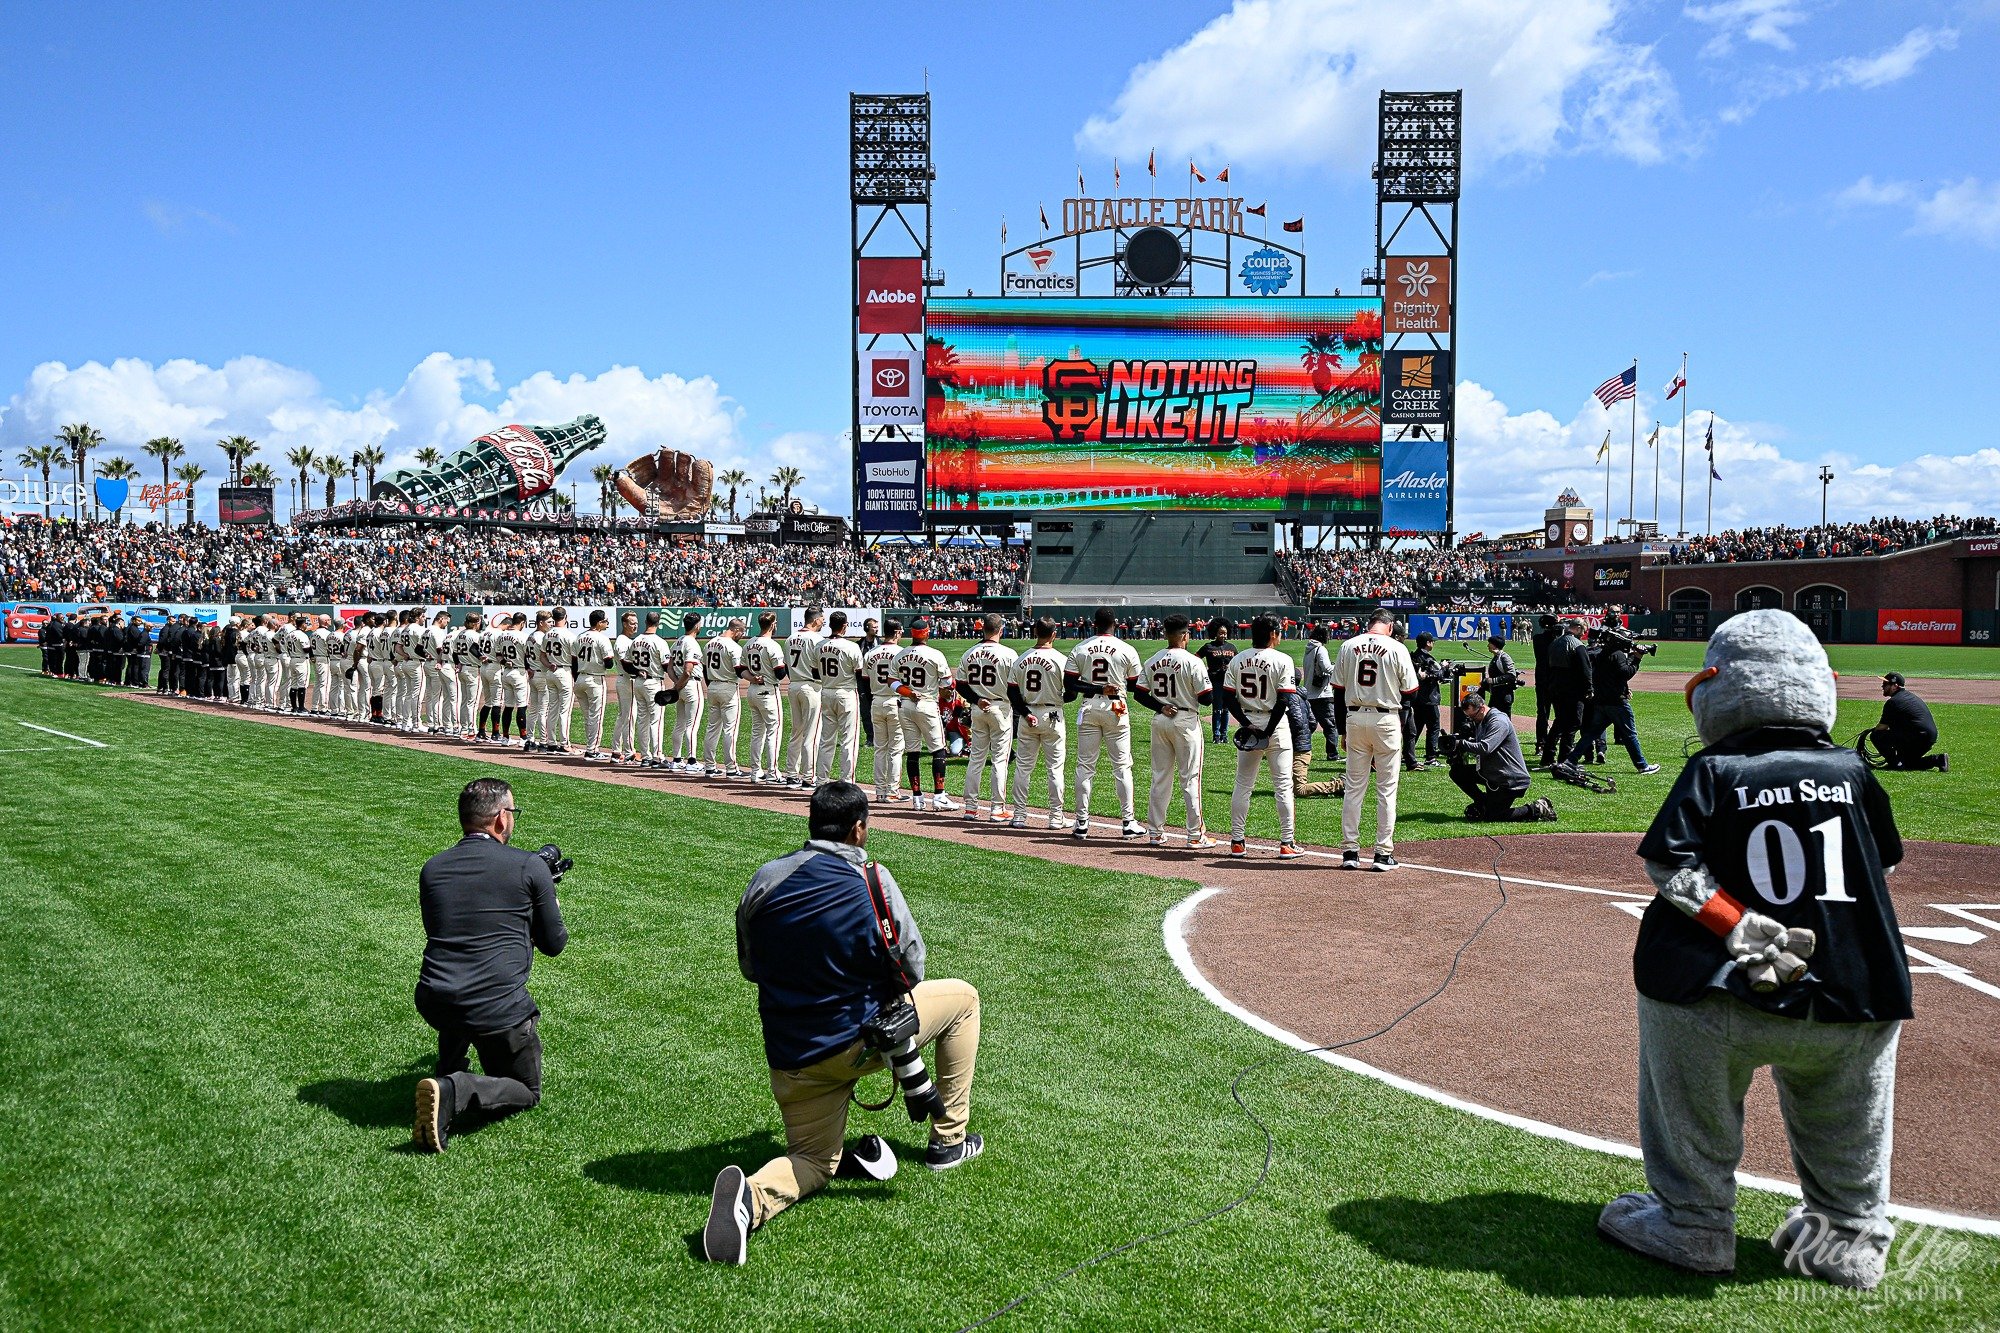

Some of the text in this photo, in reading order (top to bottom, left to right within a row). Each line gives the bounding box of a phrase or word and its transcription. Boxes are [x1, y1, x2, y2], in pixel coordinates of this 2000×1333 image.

[1062, 197, 1244, 236] ORACLE PARK
[1247, 257, 1288, 271] coupa
[1005, 272, 1075, 290] Fanatics
[866, 289, 916, 304] Adobe
[1393, 301, 1440, 316] Dignity
[1108, 361, 1254, 400] NOTHING
[1391, 389, 1441, 400] CACHE
[863, 405, 919, 417] TOYOTA
[1392, 400, 1439, 411] CREEK
[1105, 391, 1251, 439] LIKE IT
[872, 467, 910, 478] StubHub
[1384, 470, 1446, 490] Alaska
[867, 489, 915, 500] 100% VERIFIED
[865, 500, 917, 511] GIANTS TICKETS
[810, 521, 830, 534] Coffee
[1606, 568, 1630, 580] Sports
[931, 582, 958, 592] Adobe
[705, 629, 721, 637] Car
[1428, 616, 1493, 638] VISA
[1641, 628, 1658, 636] 415
[1969, 630, 1990, 640] 365
[502, 645, 517, 660] 49
[545, 641, 562, 657] 43
[578, 645, 592, 662] 41
[820, 645, 840, 656] AHMED
[1087, 645, 1117, 657] SOLER
[1352, 643, 1389, 658] MELVIN
[632, 650, 651, 667] 33
[706, 651, 721, 670] 19
[747, 653, 761, 671] 13
[790, 649, 801, 668] 7
[866, 651, 895, 671] YASTRZEM
[897, 653, 929, 668] ESTRADA
[966, 650, 1000, 666] CHAPMAN
[1019, 655, 1053, 672] CONFORTO
[1150, 657, 1171, 673] WADE
[820, 657, 839, 678] 16
[877, 663, 889, 684] 5
[968, 663, 997, 687] 26
[1091, 658, 1109, 683] 2
[1357, 659, 1378, 688] 6
[898, 665, 926, 689] 39
[1026, 669, 1042, 693] 8
[1153, 672, 1177, 699] 31
[1240, 672, 1268, 700] 51
[1734, 778, 1854, 811] Lou Seal
[1746, 815, 1857, 905] 01
[881, 918, 893, 939] EOS
